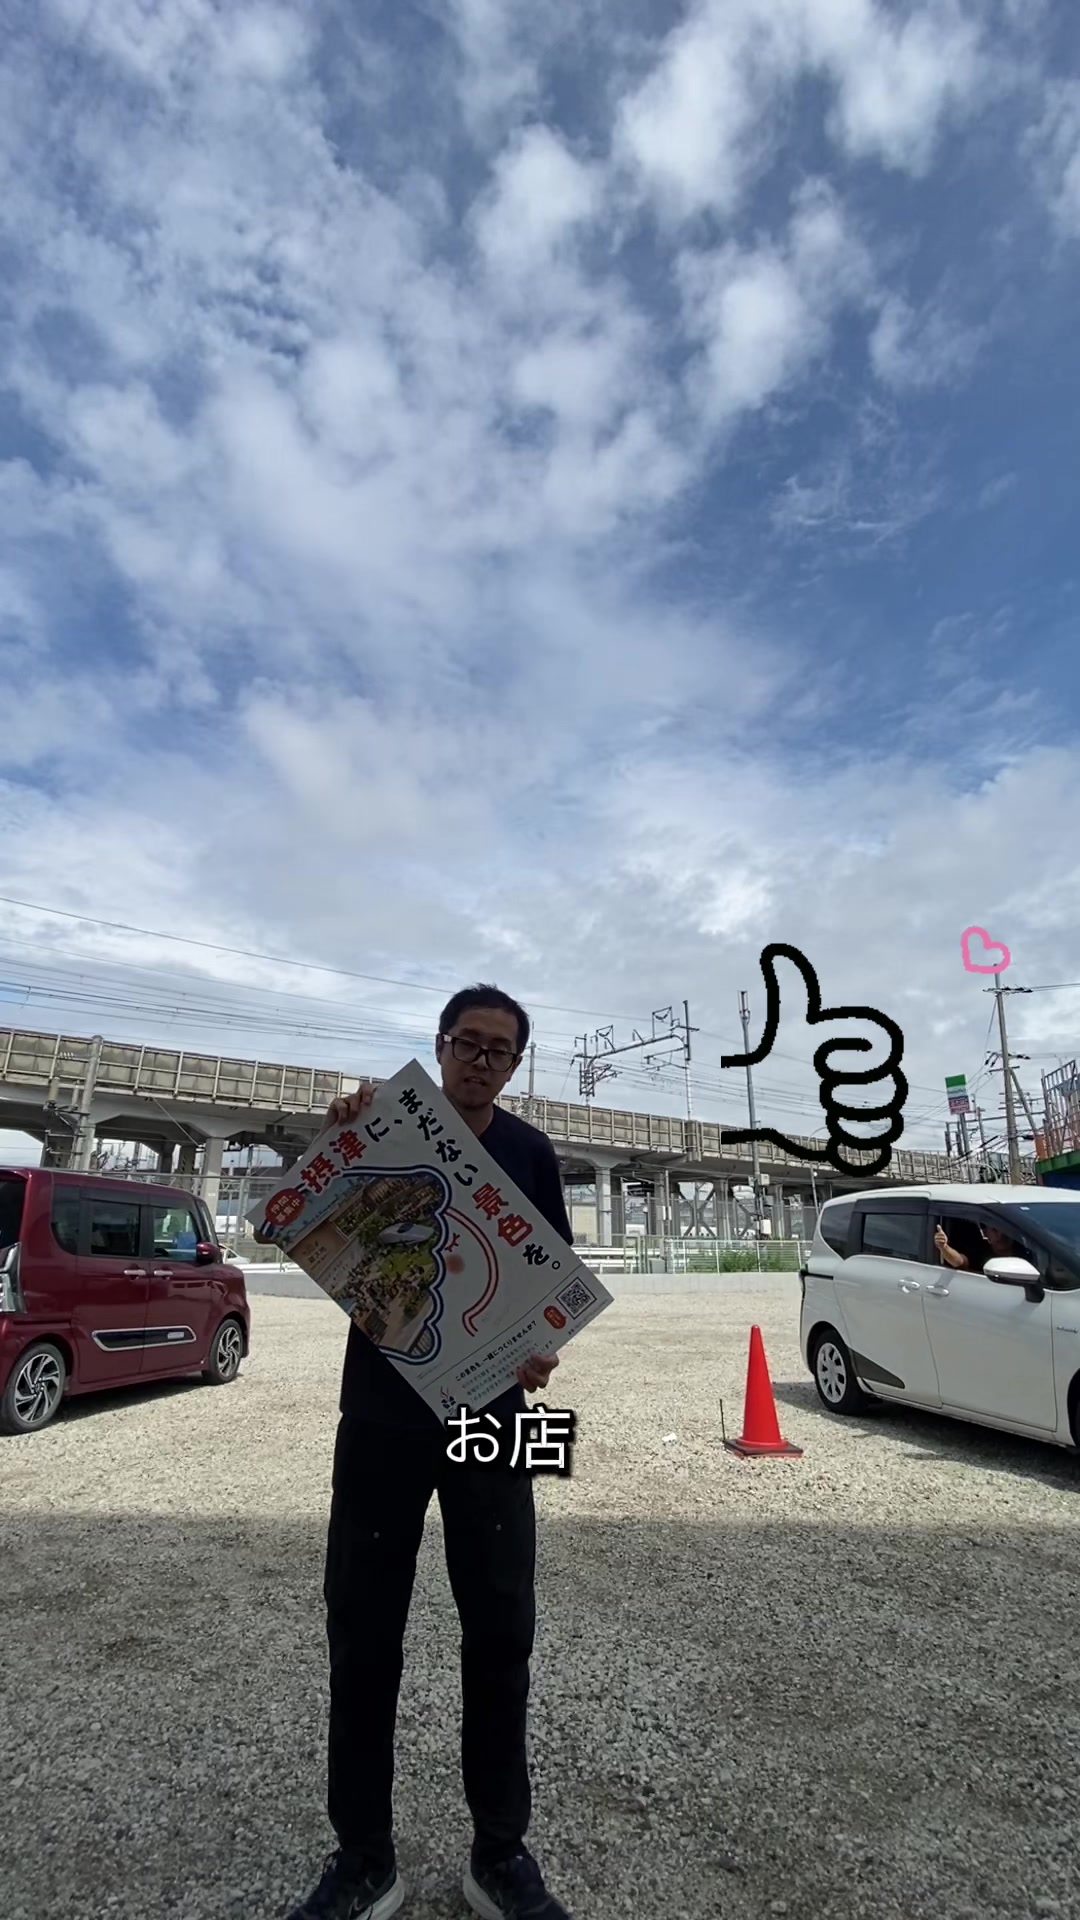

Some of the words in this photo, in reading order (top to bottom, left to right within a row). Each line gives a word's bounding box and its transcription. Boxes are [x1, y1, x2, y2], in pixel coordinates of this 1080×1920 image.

[300, 1117, 403, 1194] 摂津に、
[398, 1087, 561, 1271] まだない景色を。
